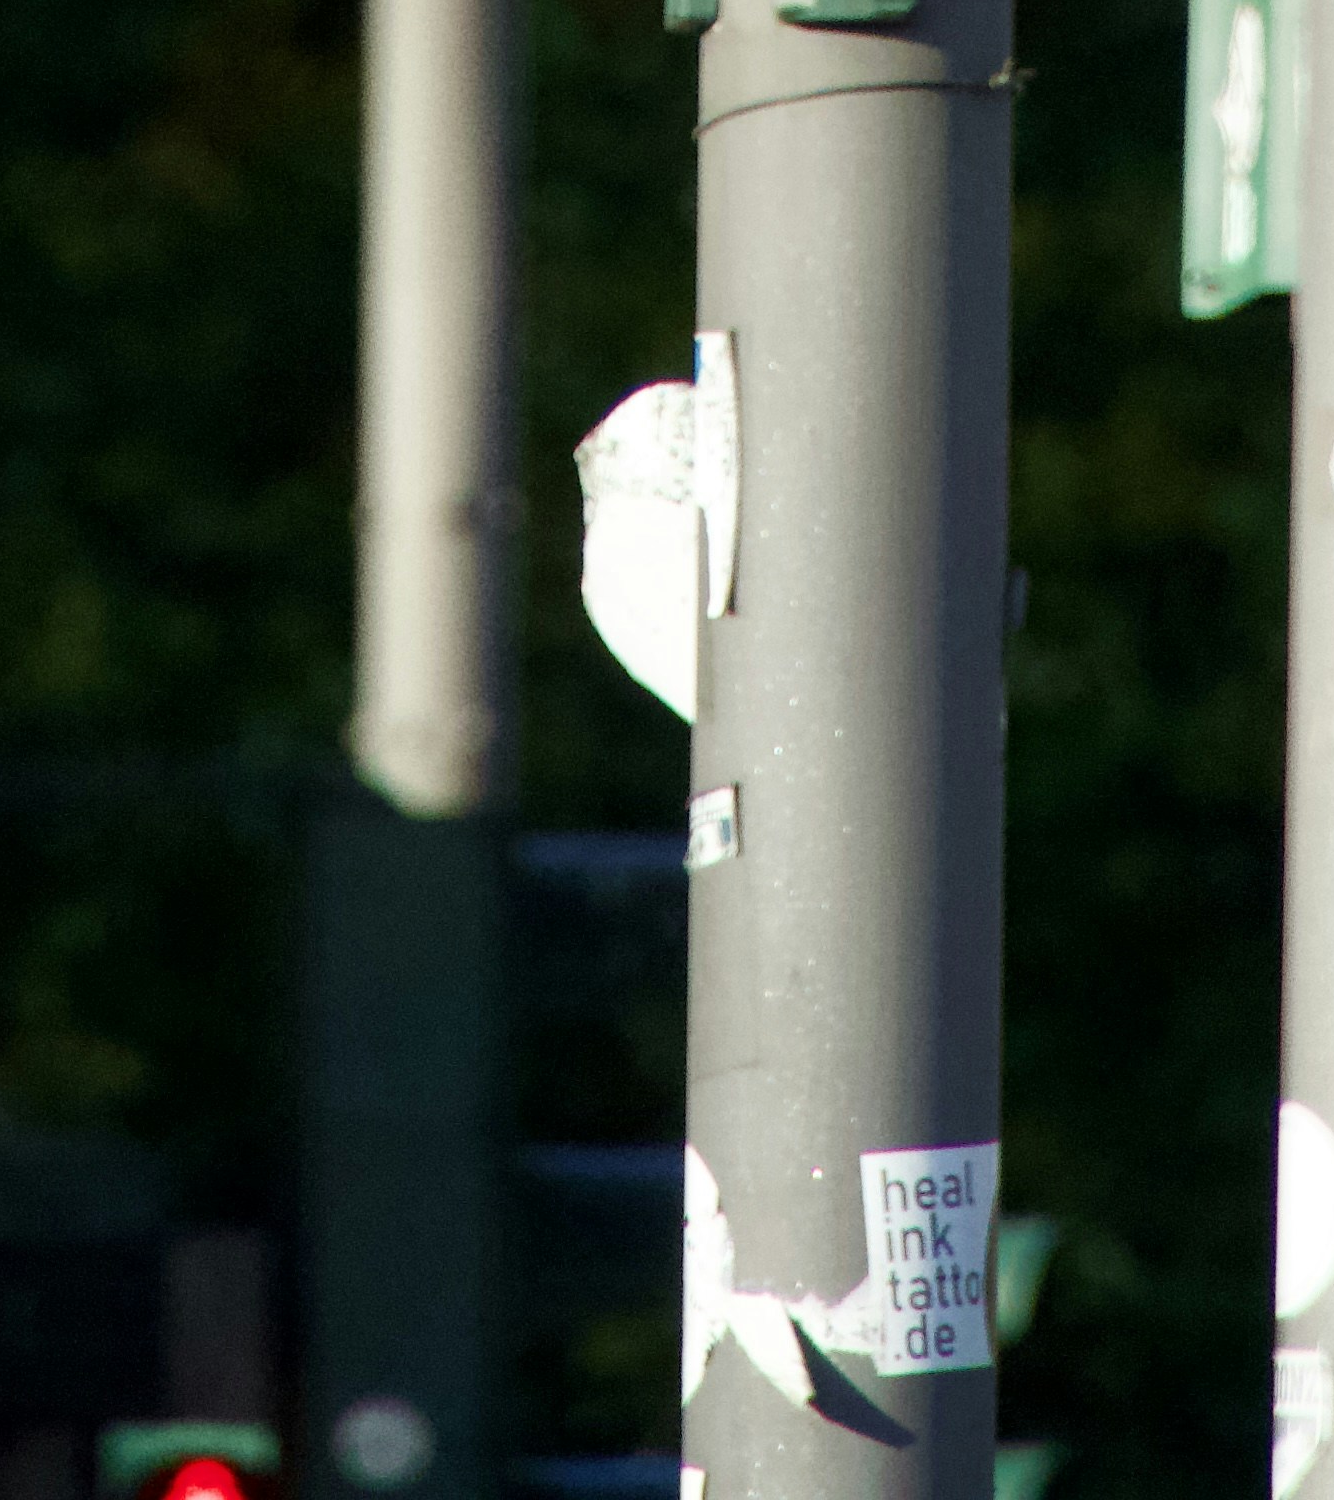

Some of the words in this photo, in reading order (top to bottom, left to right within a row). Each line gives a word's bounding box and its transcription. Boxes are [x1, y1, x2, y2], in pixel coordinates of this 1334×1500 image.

[880, 1160, 976, 1212] heal
[884, 1212, 955, 1262] ink
[894, 1313, 956, 1360] .de
